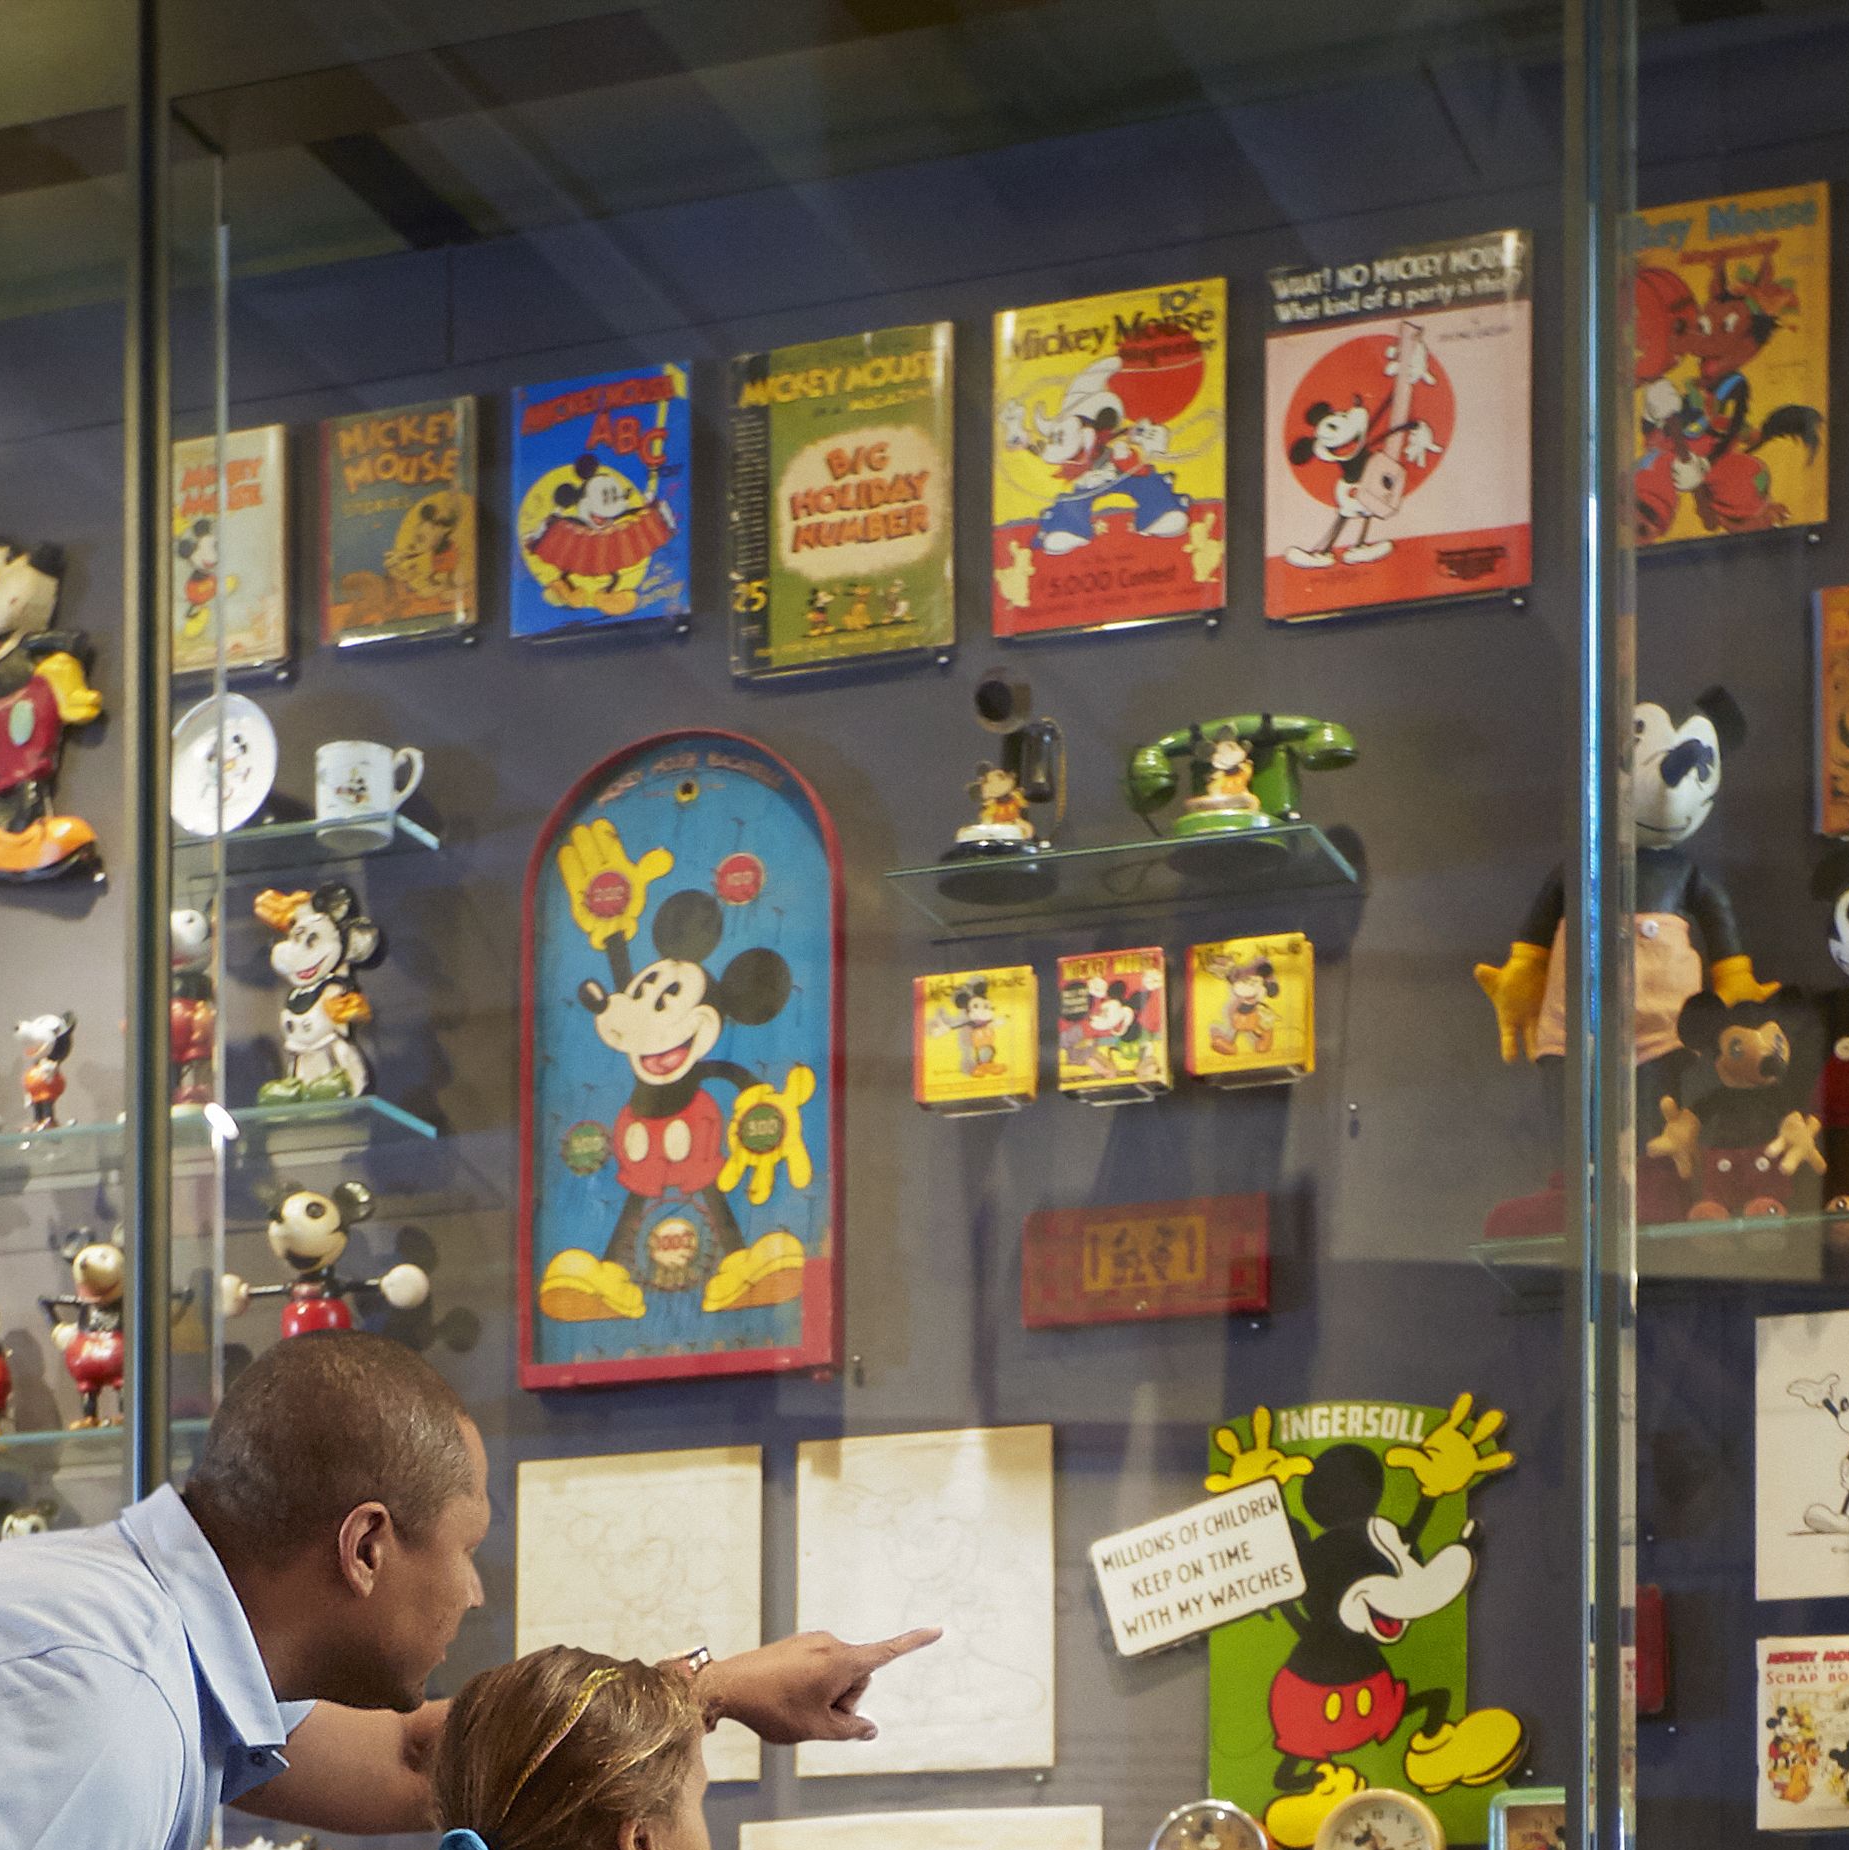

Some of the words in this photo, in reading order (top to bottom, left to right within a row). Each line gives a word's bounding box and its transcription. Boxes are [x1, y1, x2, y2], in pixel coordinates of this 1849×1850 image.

[1337, 263, 1370, 290] NO
[1010, 320, 1112, 362] Mickey
[1114, 306, 1218, 344] Mouse
[739, 367, 842, 409] MICKEY
[338, 410, 456, 457] MICKEY
[343, 448, 460, 494] MOUSE
[825, 442, 890, 480] BIG
[789, 470, 930, 522] HOLIDAY
[791, 503, 930, 553] NUMBER
[1280, 1406, 1427, 1444] INGERSOLL
[1102, 1532, 1176, 1574] MILLIONS
[1180, 1518, 1201, 1546] OF
[1203, 1494, 1281, 1538] CHILDREN
[1131, 1571, 1175, 1601] KEEP
[1177, 1559, 1205, 1586] ON
[1208, 1540, 1255, 1574] TIME
[1122, 1606, 1171, 1638] WITH
[1176, 1595, 1204, 1621] MY
[1207, 1562, 1295, 1611] WATCHES
[1766, 1671, 1818, 1686] SCRAP
